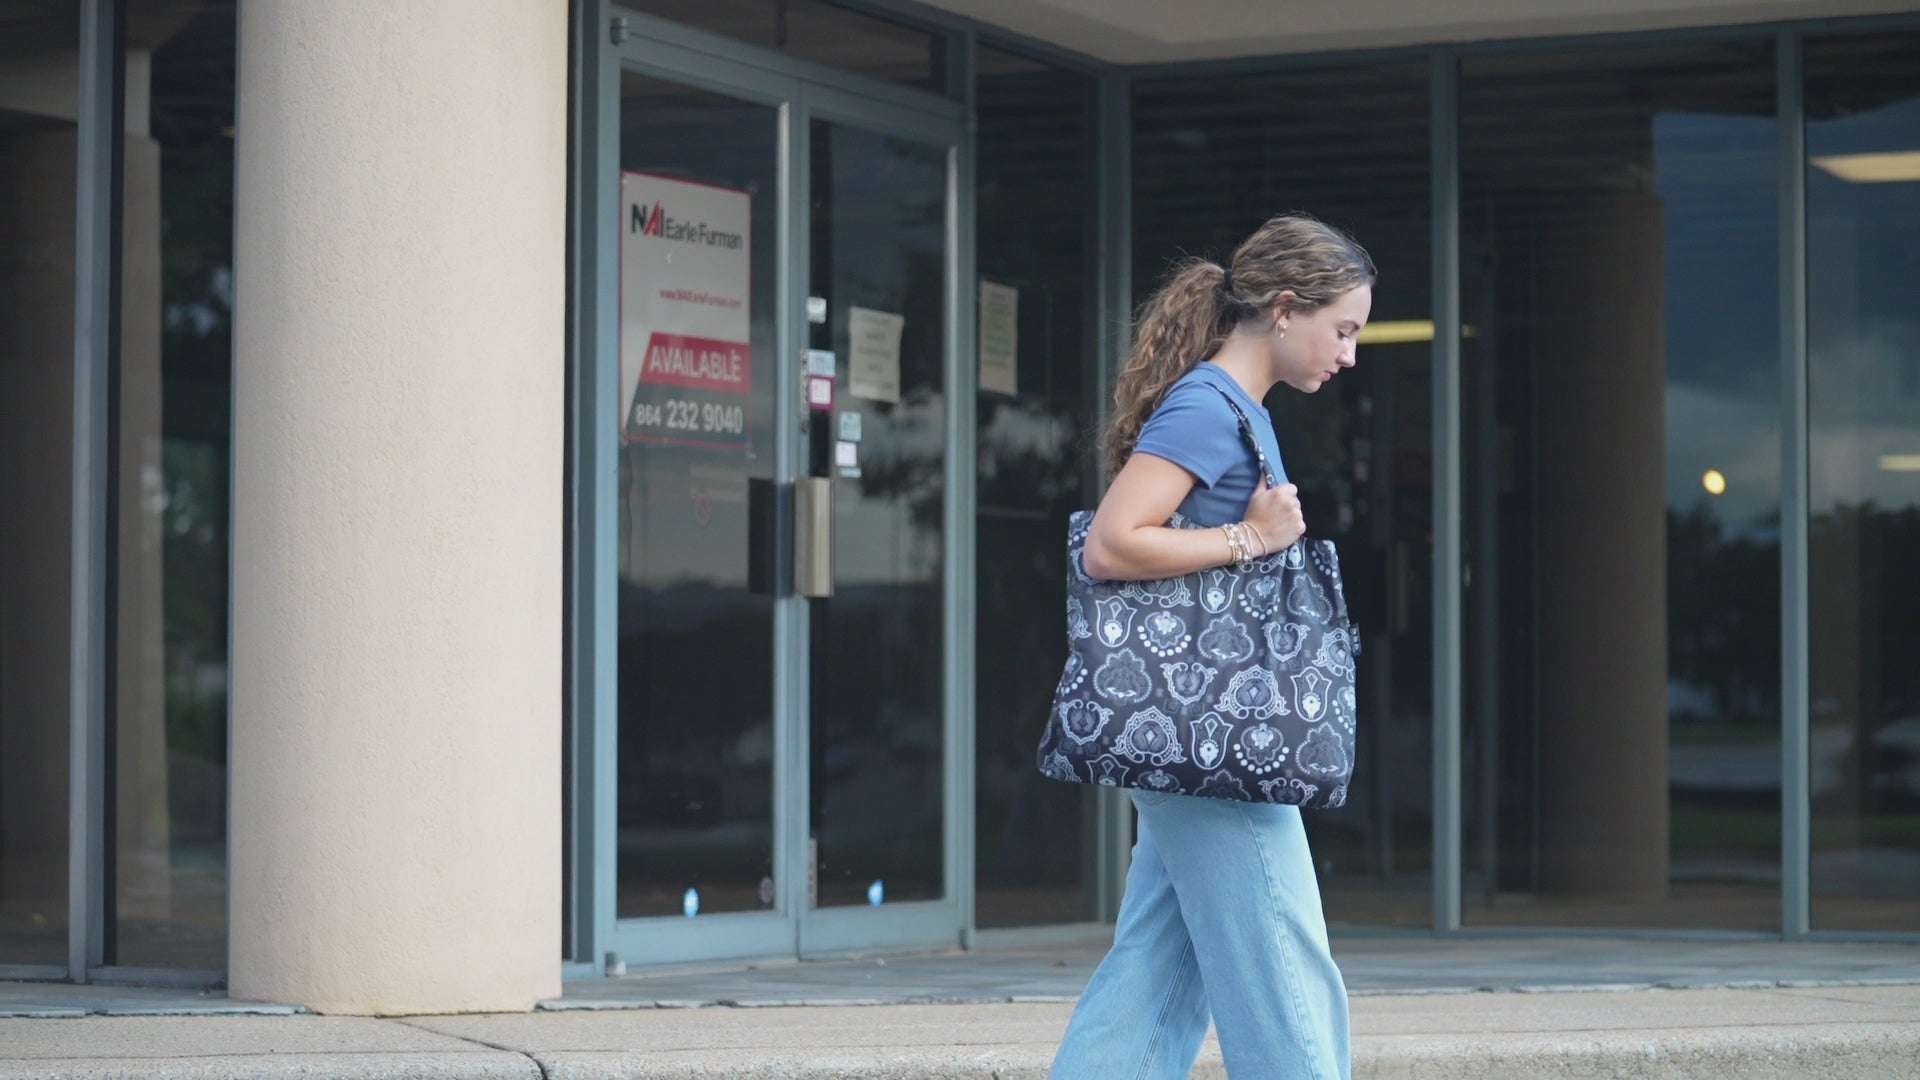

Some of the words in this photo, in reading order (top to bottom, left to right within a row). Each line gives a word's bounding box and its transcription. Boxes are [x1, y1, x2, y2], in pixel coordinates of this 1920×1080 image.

[632, 199, 665, 239] NAI
[666, 219, 697, 243] Earle
[699, 222, 743, 249] Furman
[650, 345, 742, 381] AVAILABLE
[636, 404, 662, 427] 864
[666, 400, 699, 430] 232
[703, 403, 743, 433] 9040
